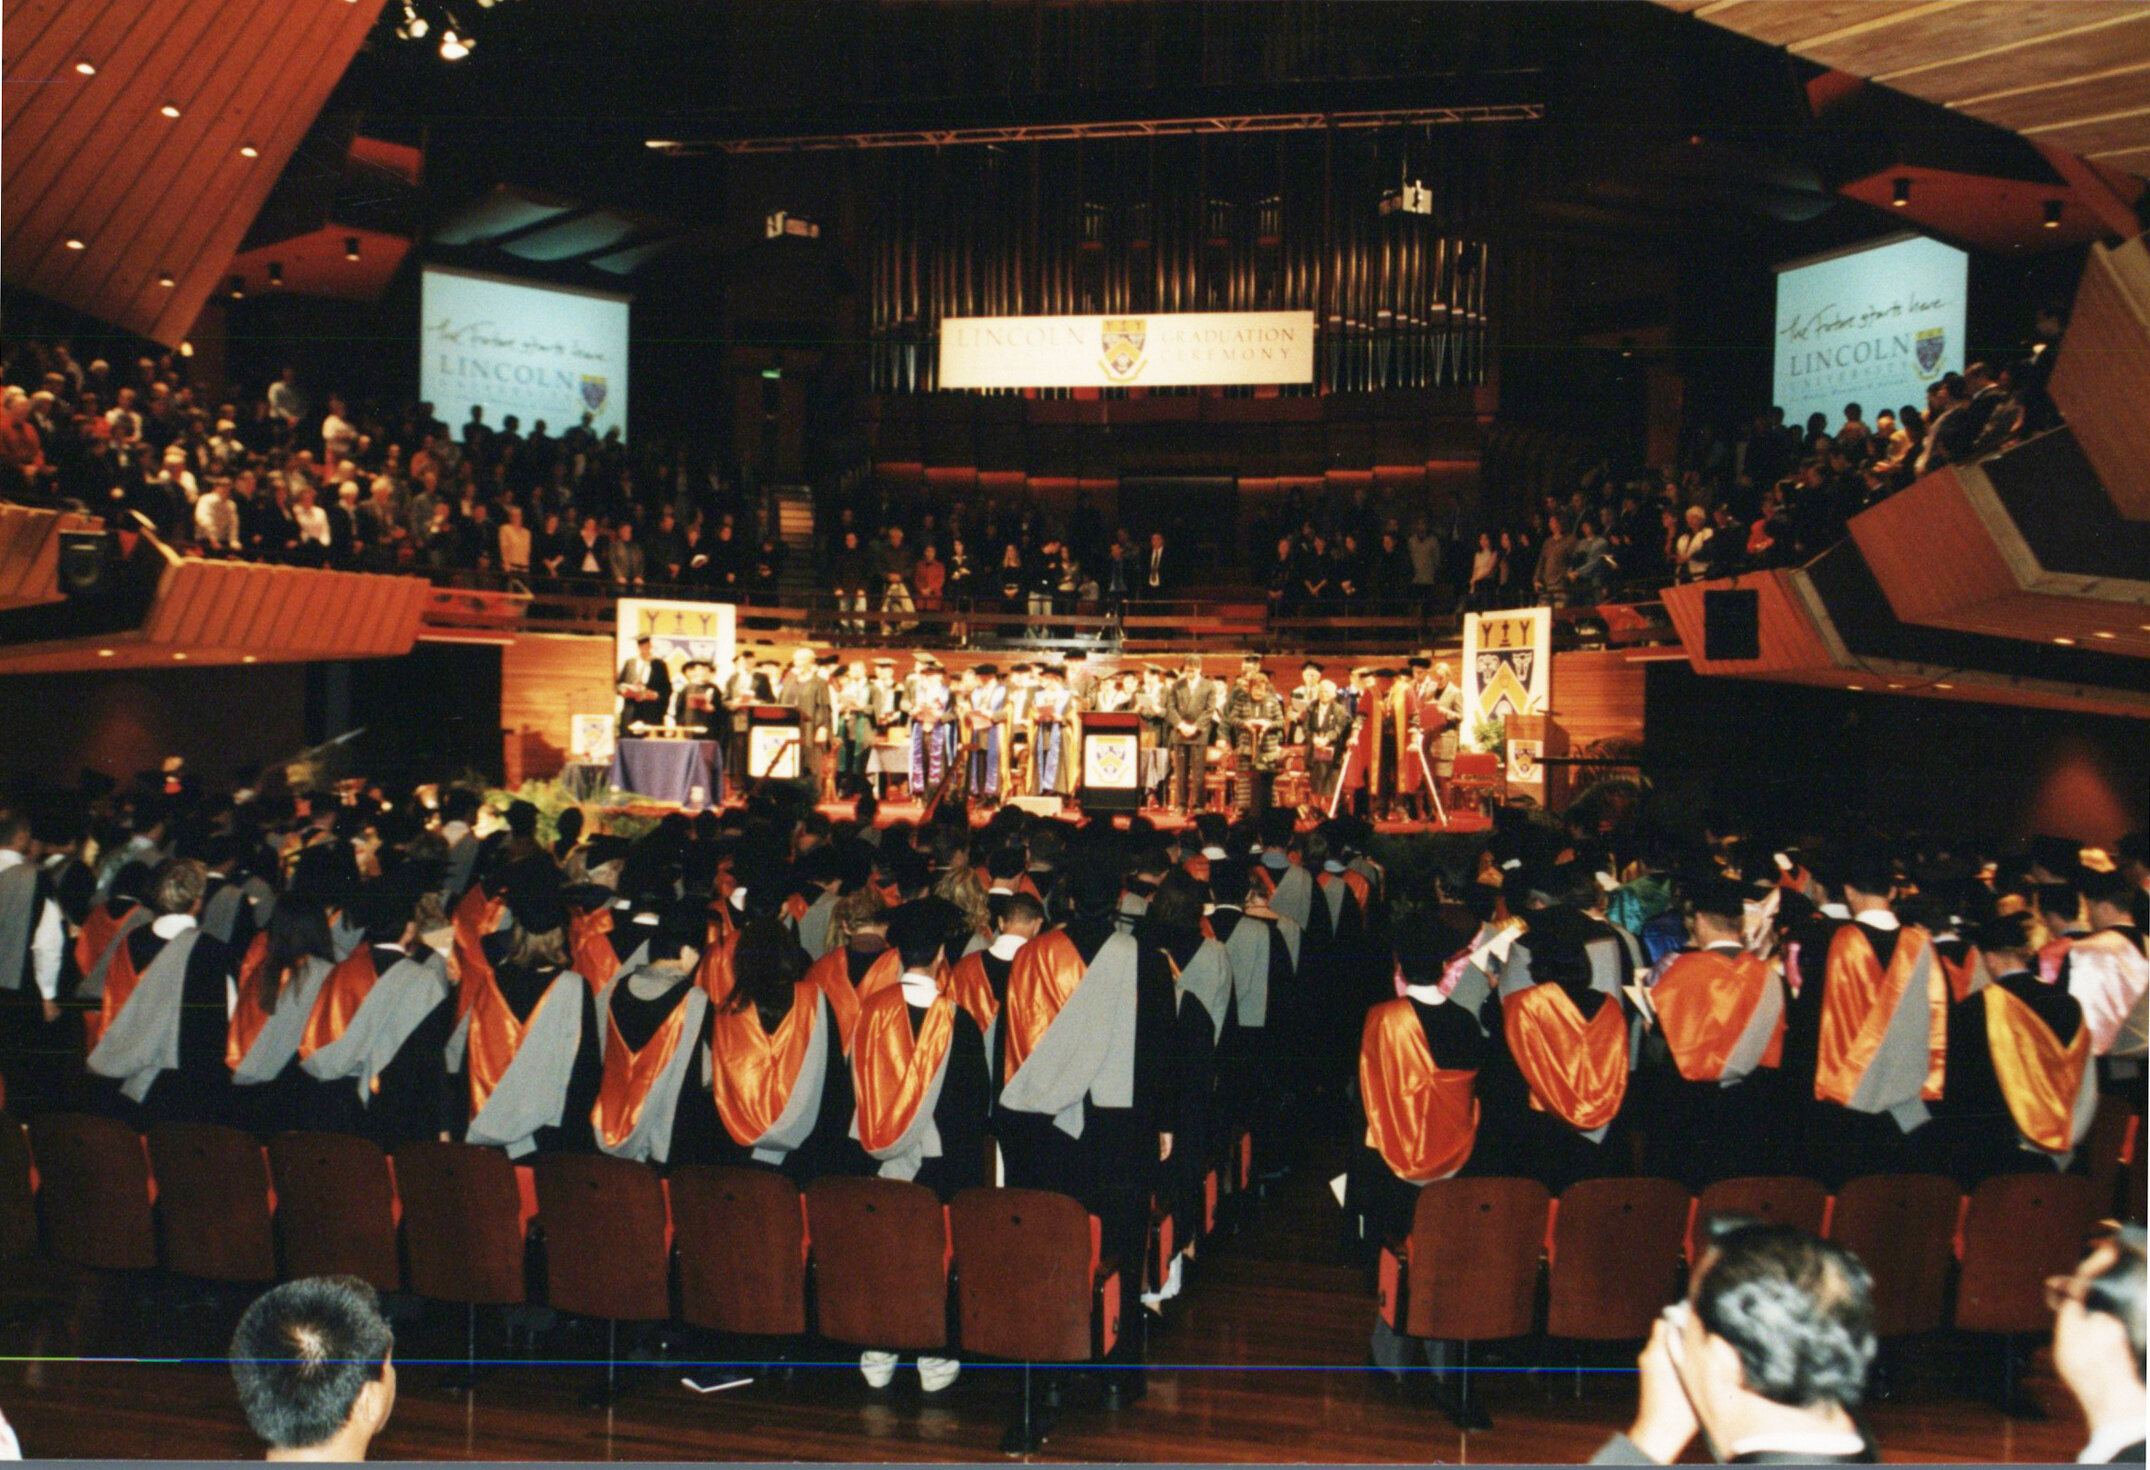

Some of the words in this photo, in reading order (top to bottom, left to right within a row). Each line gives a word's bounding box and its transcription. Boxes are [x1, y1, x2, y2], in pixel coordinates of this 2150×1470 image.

[957, 326, 1084, 347] LINCOLN
[1161, 326, 1295, 344] GRADUATION
[1162, 346, 1290, 362] CEREMONY
[1790, 334, 1911, 377] LINCOLN
[440, 354, 574, 390] LINCOLN
